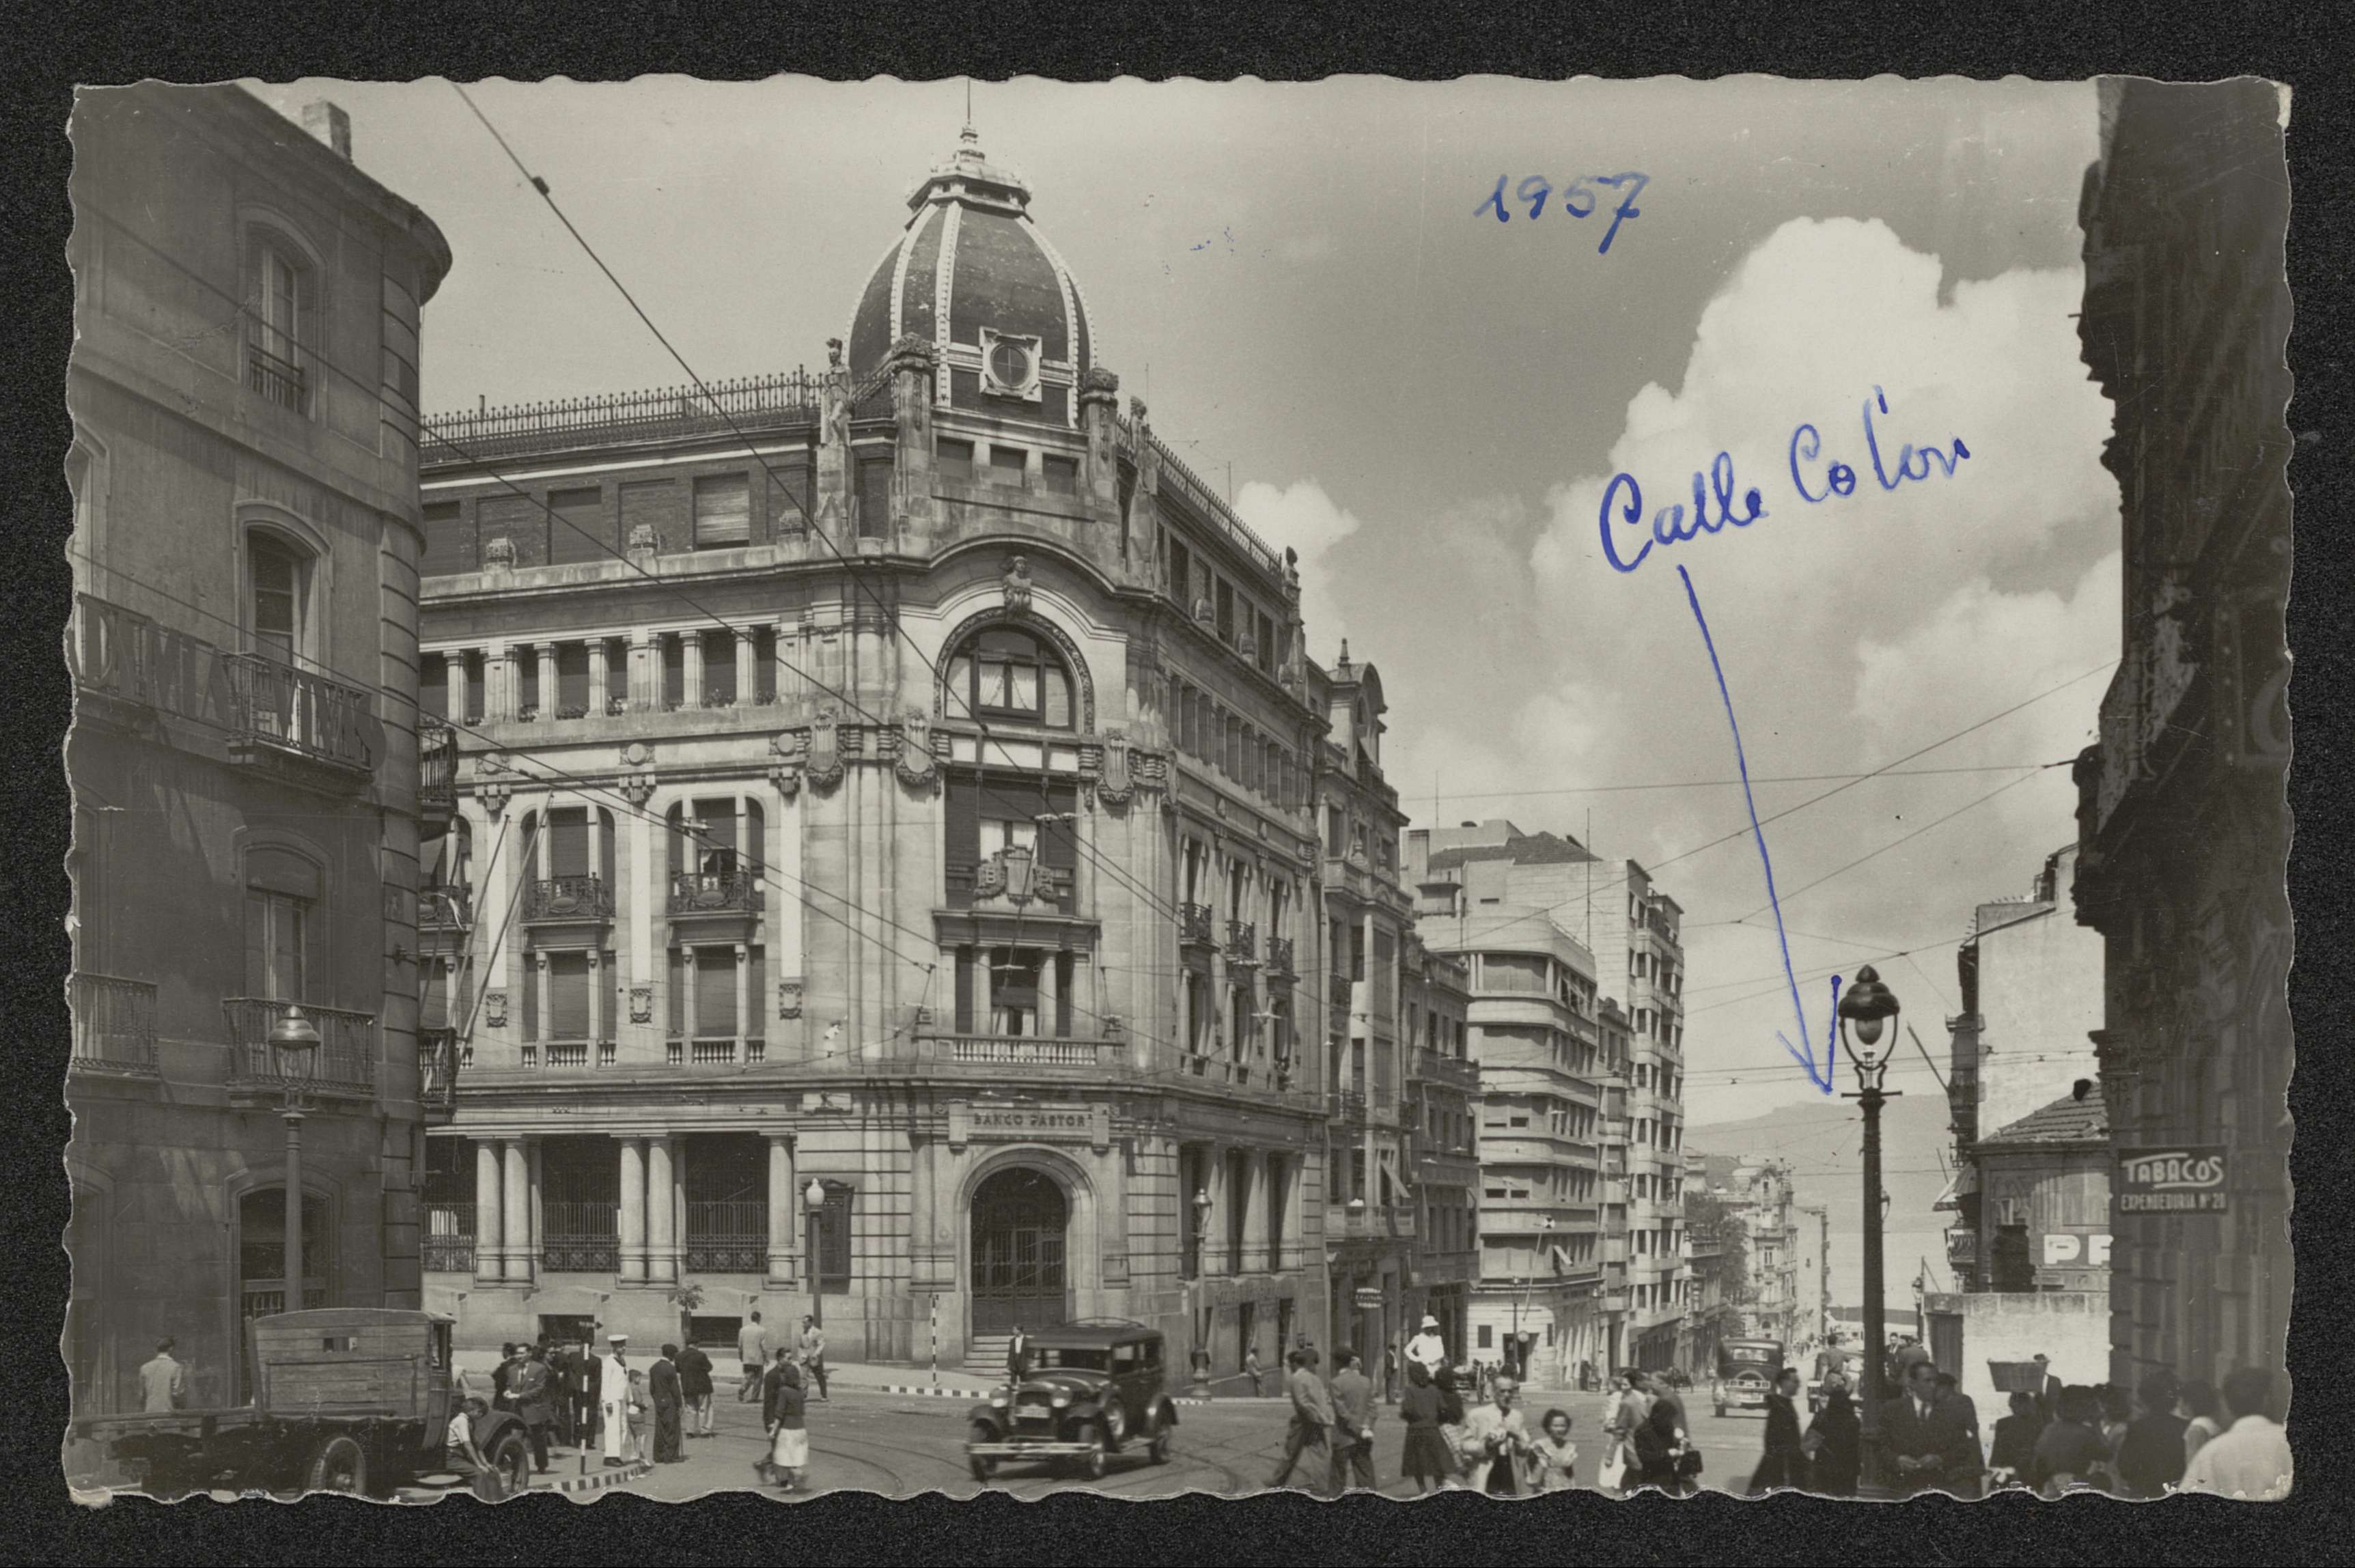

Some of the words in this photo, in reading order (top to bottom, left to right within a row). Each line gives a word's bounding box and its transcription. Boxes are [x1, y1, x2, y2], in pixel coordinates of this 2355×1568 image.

[1473, 171, 1650, 254] 1957
[1599, 451, 1769, 573] Calle
[973, 1112, 1025, 1126] BANCO
[1029, 1114, 1087, 1128] PASTOR
[2121, 1151, 2225, 1190] TABACOS
